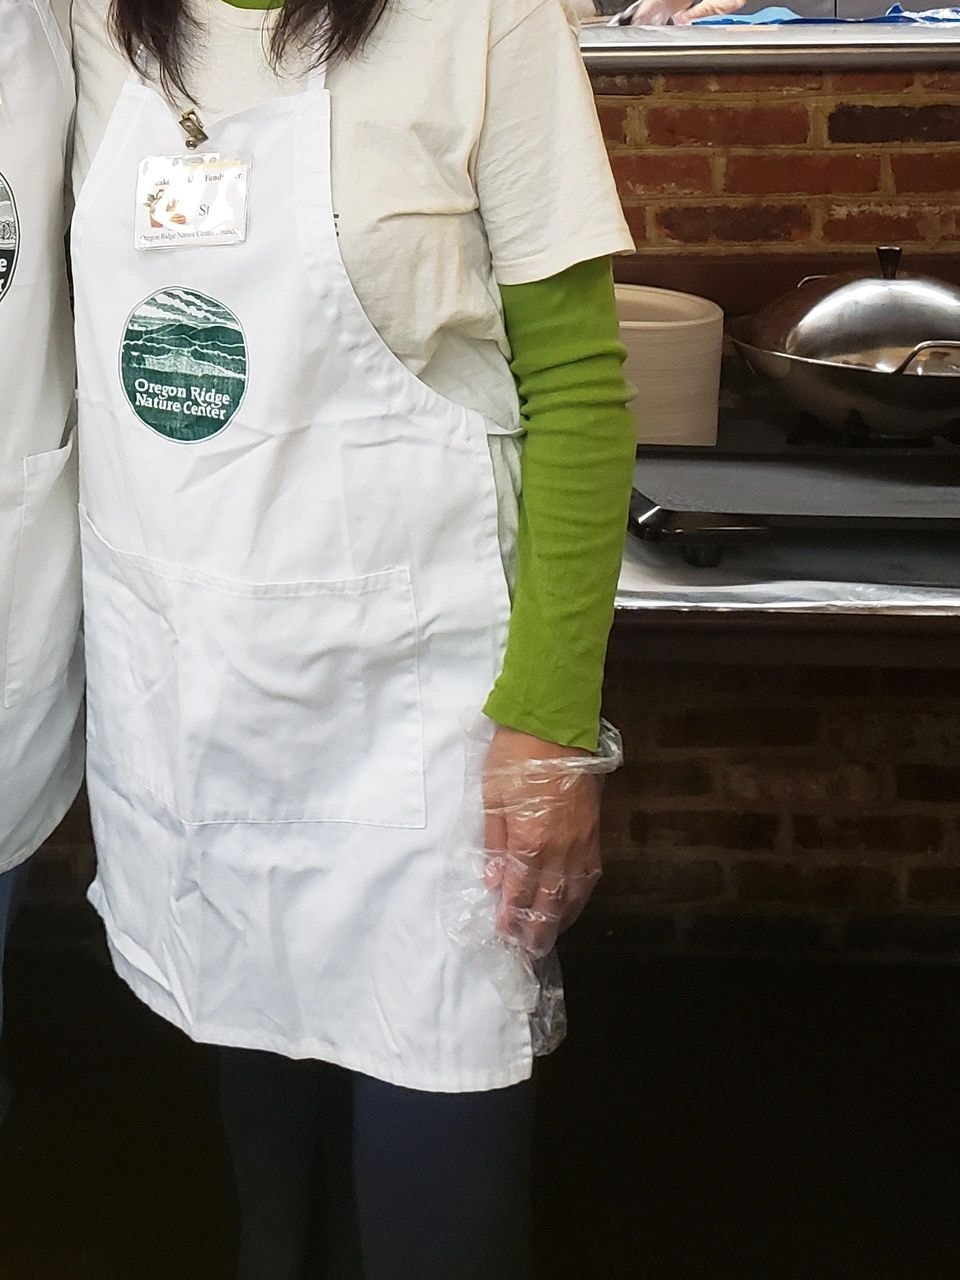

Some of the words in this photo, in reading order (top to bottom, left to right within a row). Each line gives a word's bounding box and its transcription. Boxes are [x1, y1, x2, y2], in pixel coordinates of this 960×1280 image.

[134, 378, 186, 399] Oregon
[190, 386, 231, 408] Ridge
[135, 393, 181, 412] Nature
[183, 401, 227, 420] Center
